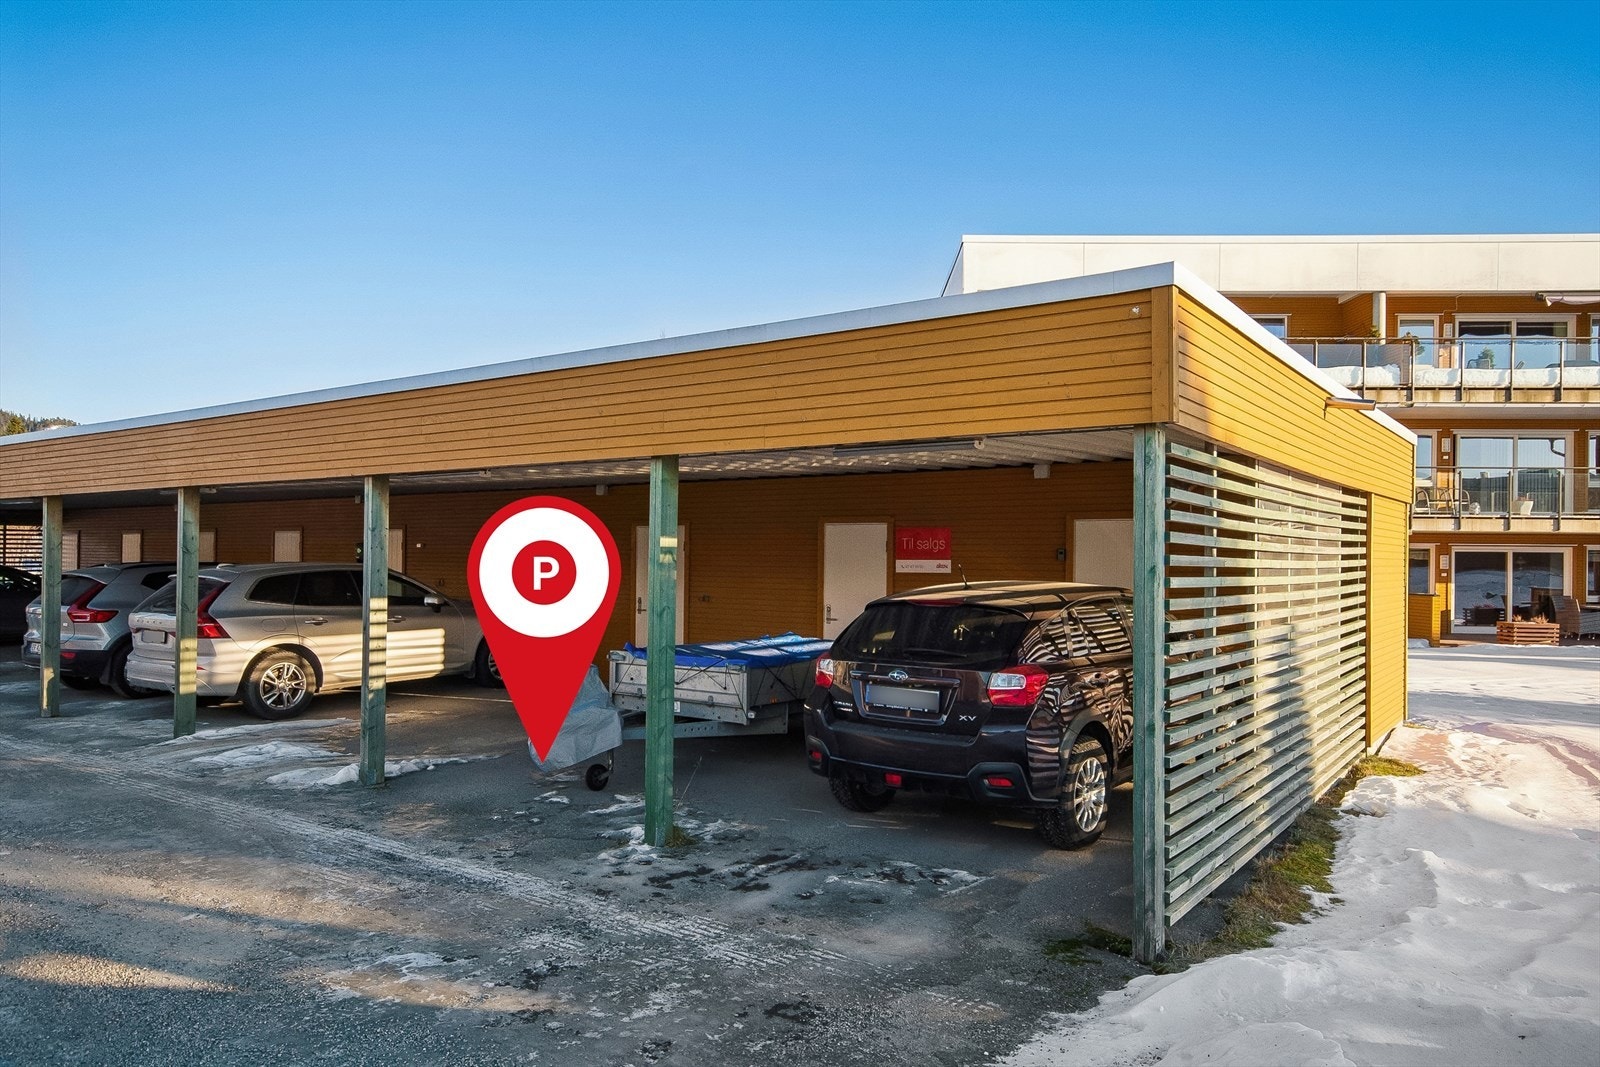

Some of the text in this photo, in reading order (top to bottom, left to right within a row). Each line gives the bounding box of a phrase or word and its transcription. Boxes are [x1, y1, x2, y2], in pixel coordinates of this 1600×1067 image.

[901, 537, 946, 553] Til salgs
[958, 714, 977, 722] XV
